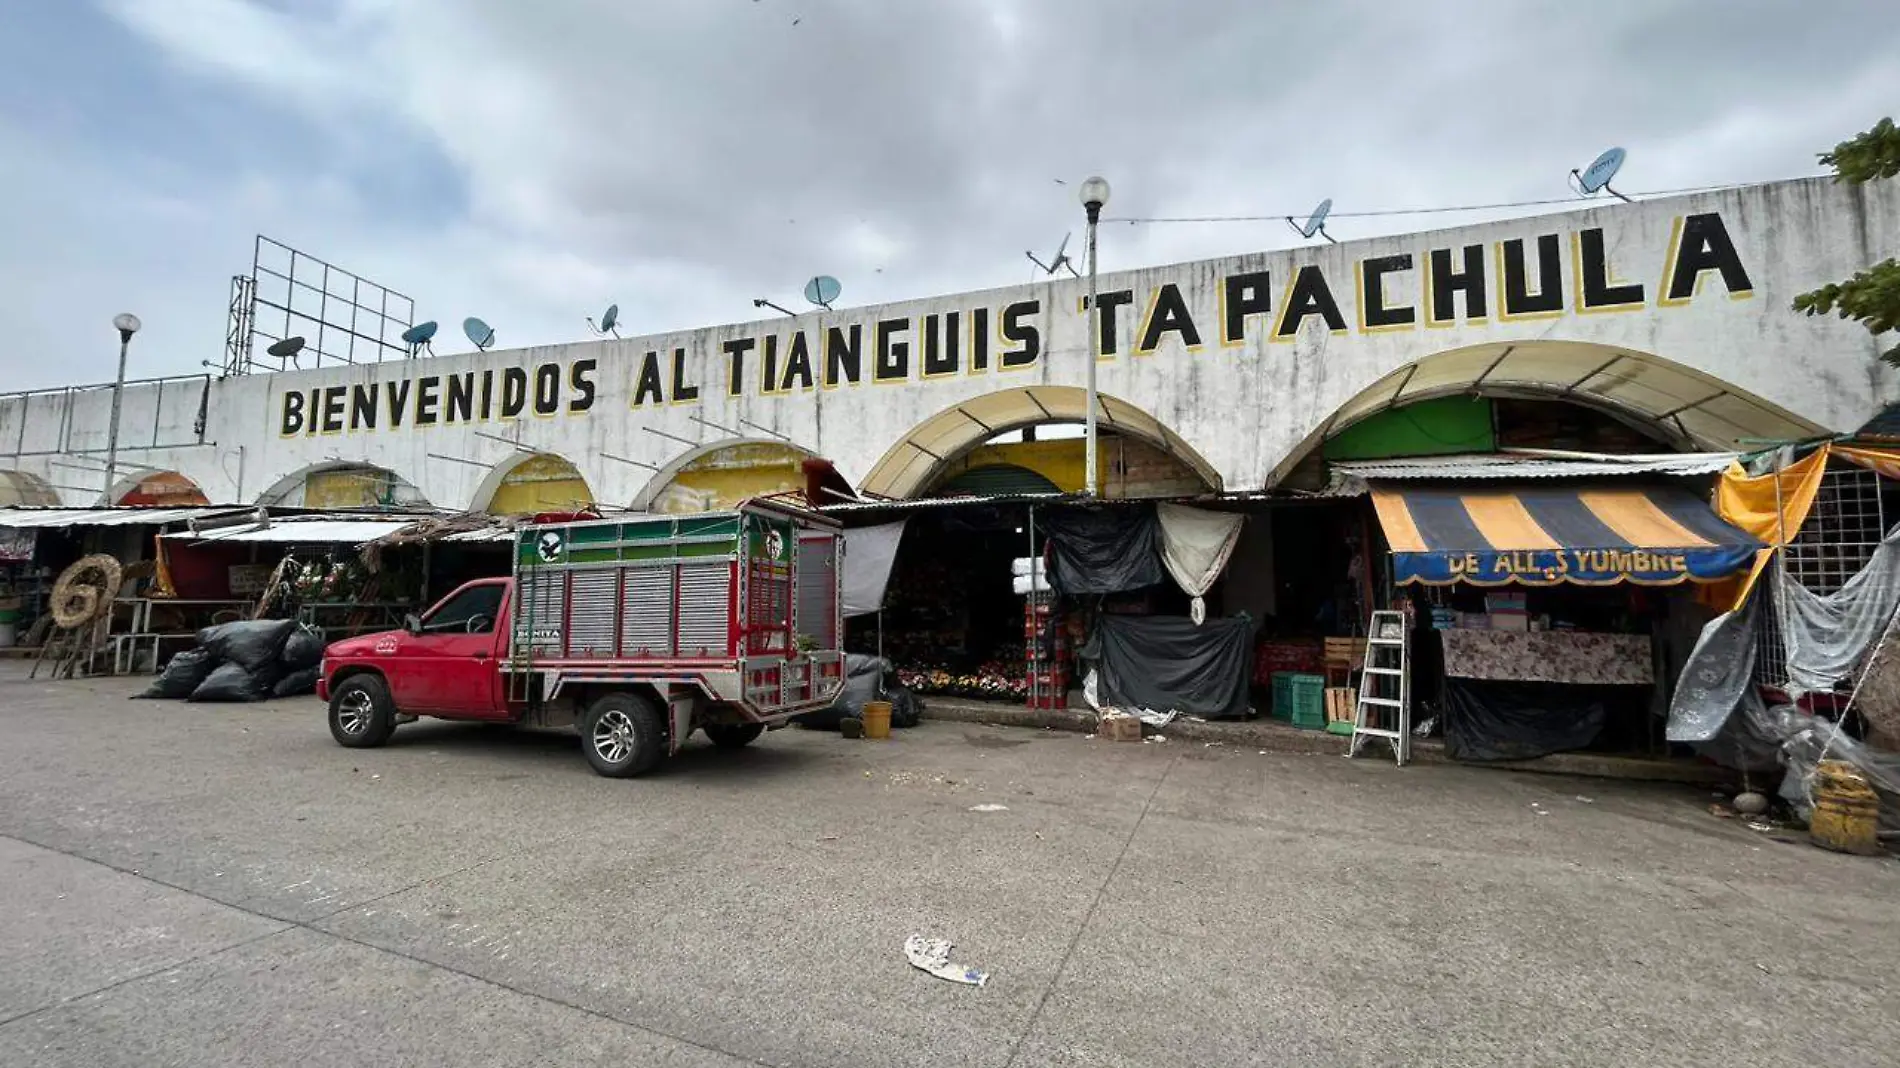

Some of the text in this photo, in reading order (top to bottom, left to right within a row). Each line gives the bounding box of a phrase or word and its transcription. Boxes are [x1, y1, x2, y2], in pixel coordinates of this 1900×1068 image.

[280, 211, 1753, 437] BIENVENIDOS AL TIANGUIS TAPACHULA
[1449, 553, 1479, 573] DE
